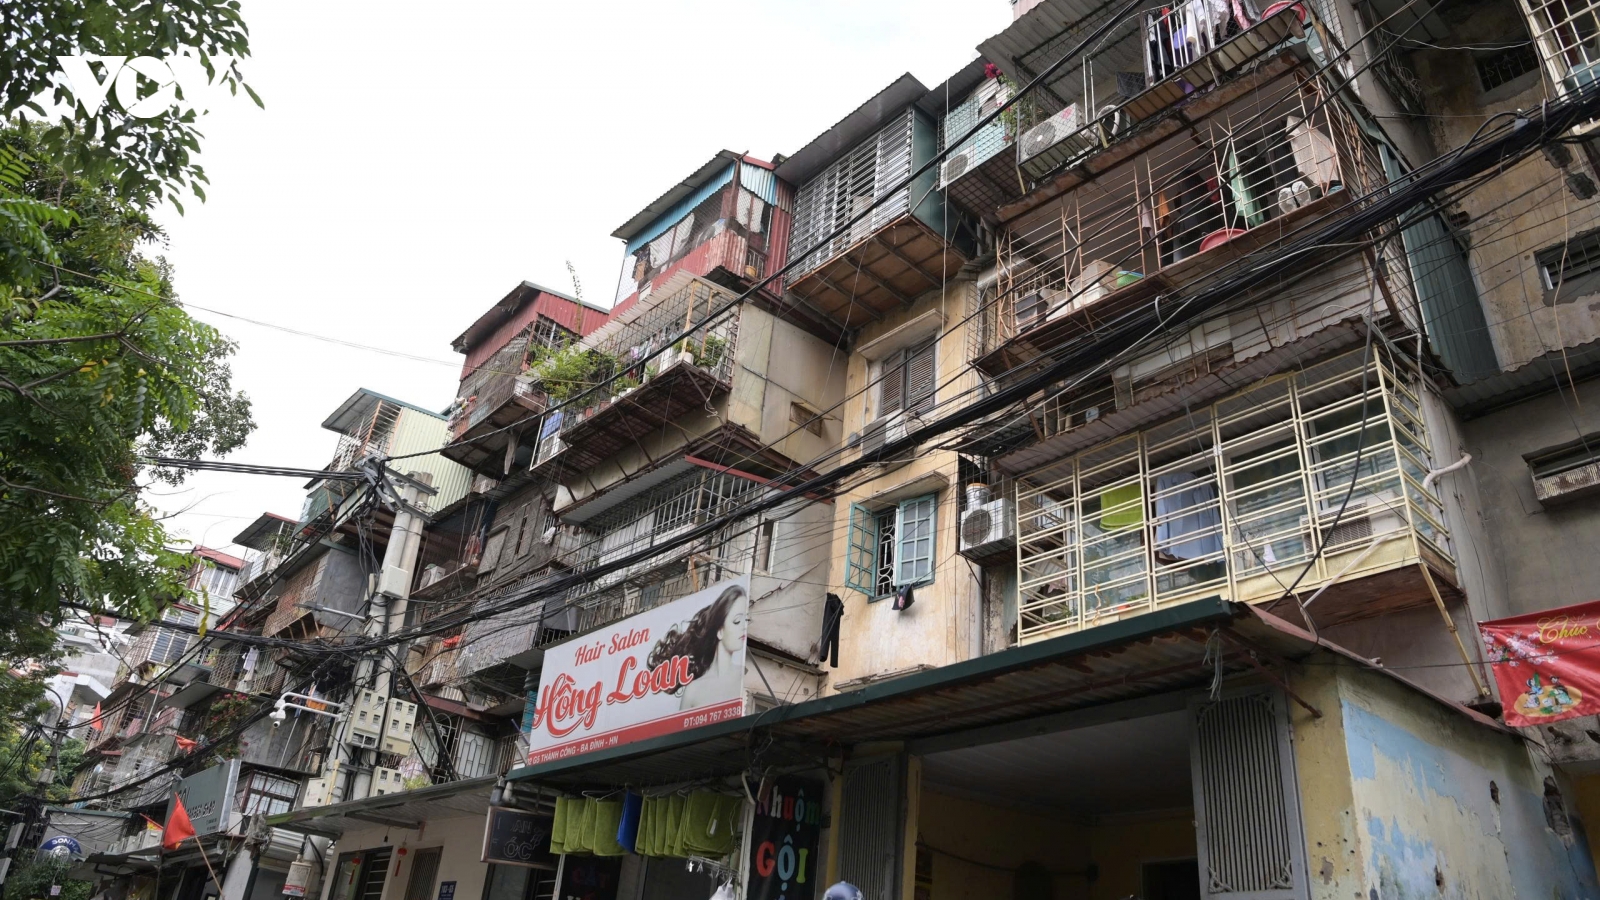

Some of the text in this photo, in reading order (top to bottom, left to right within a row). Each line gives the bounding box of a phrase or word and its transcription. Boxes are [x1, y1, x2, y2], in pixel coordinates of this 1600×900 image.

[1537, 615, 1588, 643] Chúc
[575, 628, 650, 666] Hair Salon
[532, 656, 694, 738] Hồng Loan
[709, 710, 722, 722] 767
[723, 706, 741, 719] 3338
[580, 744, 588, 752] BA
[609, 735, 619, 745] HN
[756, 834, 809, 892] GỘI
